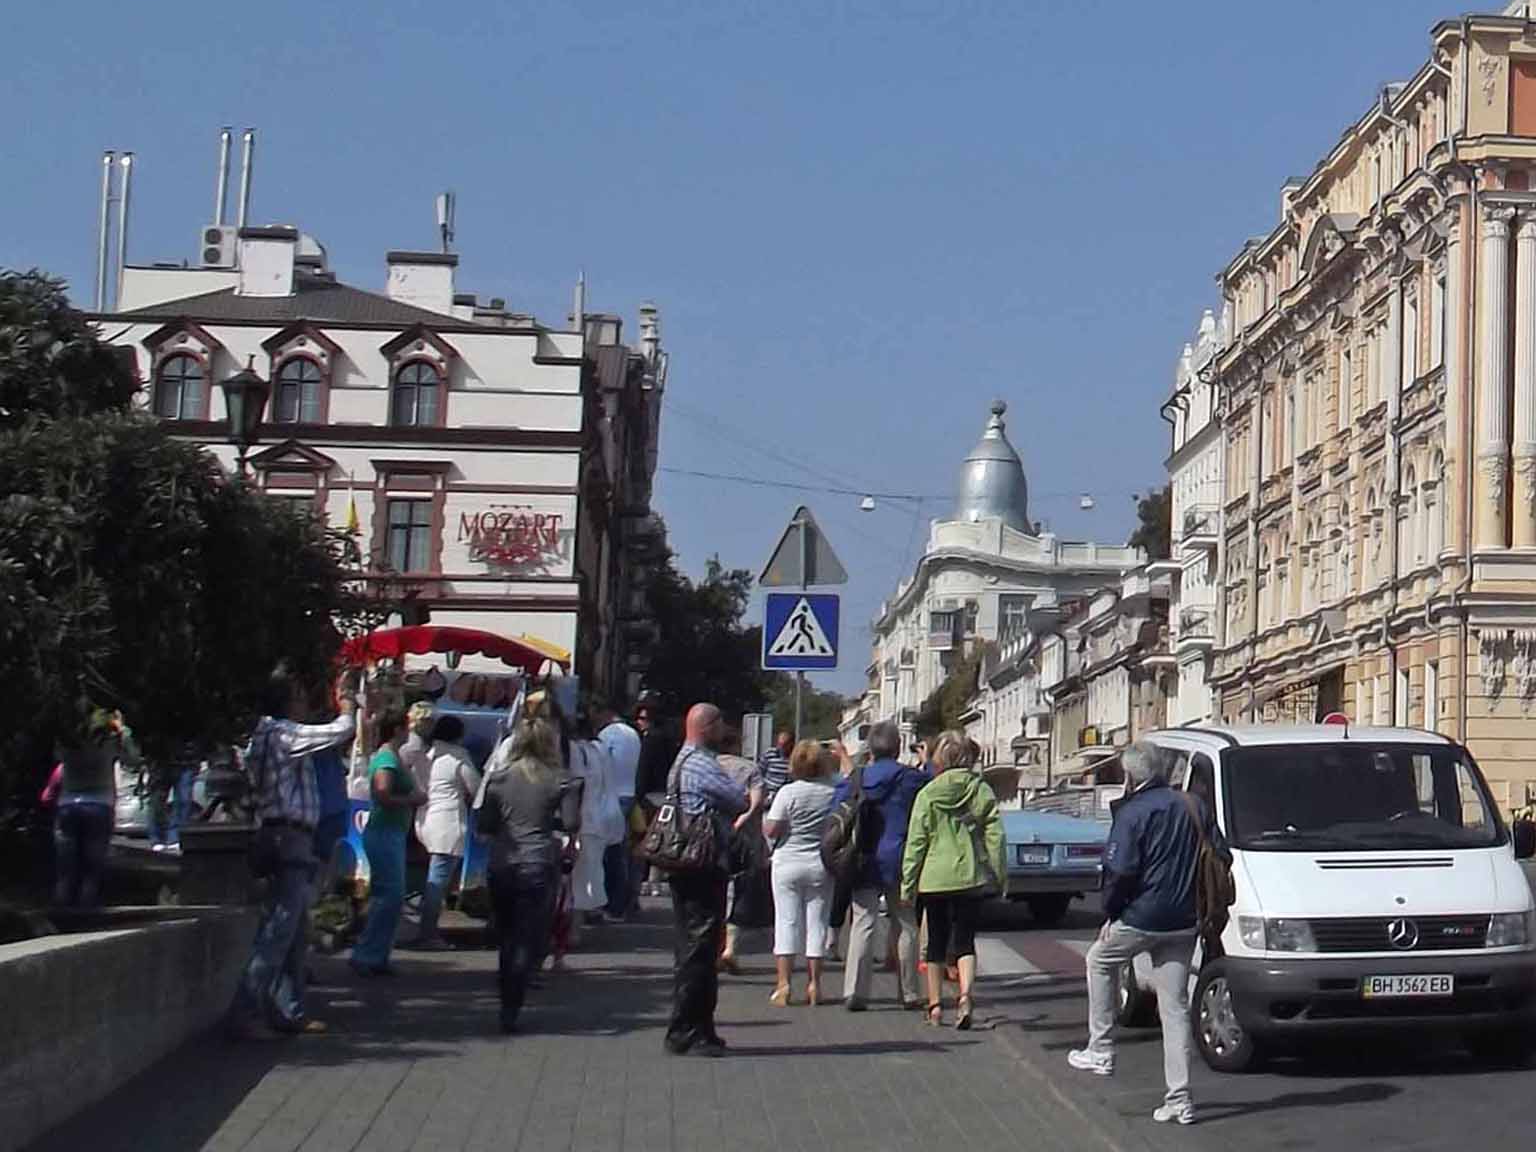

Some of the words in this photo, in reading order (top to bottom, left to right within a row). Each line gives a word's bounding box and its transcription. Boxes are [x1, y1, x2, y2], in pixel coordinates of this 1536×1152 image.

[457, 511, 563, 546] MOZART
[1372, 978, 1393, 993] BH
[1397, 977, 1428, 993] 3562
[1430, 976, 1451, 993] EB
